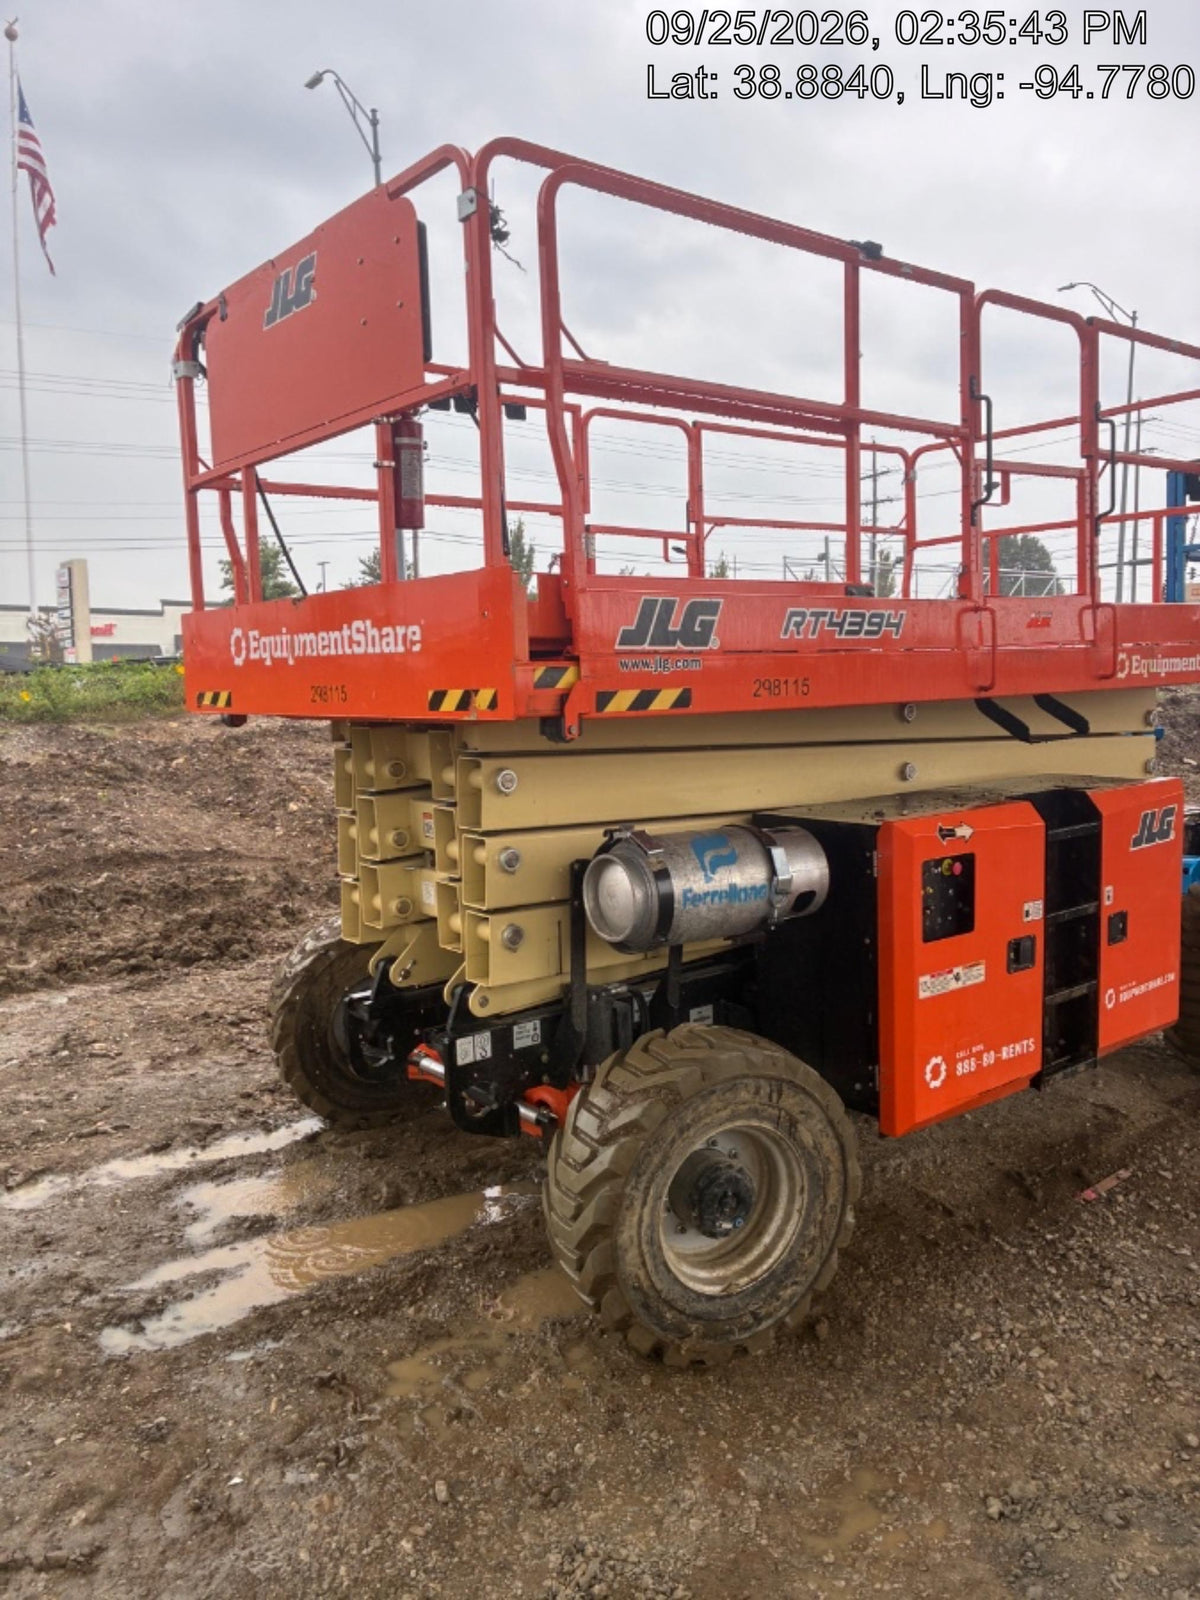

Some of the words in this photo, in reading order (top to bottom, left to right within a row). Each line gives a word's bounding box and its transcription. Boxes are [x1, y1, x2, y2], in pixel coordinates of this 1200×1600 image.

[262, 250, 318, 332] JLG
[614, 596, 723, 649] JLG
[780, 607, 906, 639] RT4394
[619, 656, 702, 673] www.jlg.com
[310, 684, 348, 703] 298115
[752, 677, 810, 698] 298115
[1128, 803, 1178, 852] JLG
